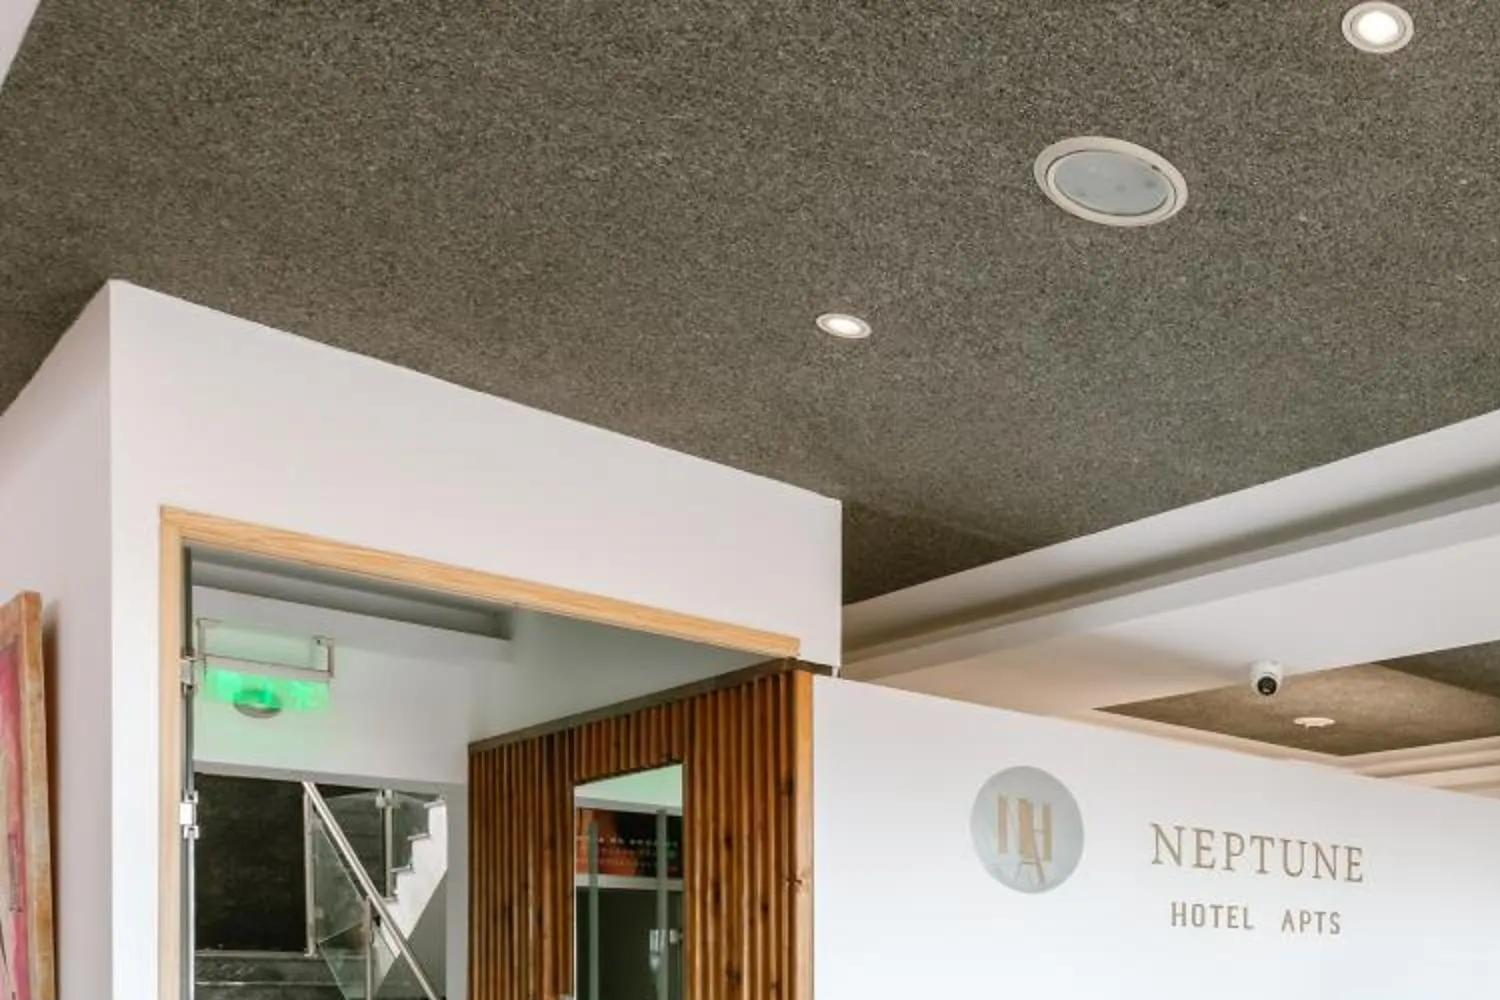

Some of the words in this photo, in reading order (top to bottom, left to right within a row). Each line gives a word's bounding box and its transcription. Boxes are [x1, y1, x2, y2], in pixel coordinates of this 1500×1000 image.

[1150, 823, 1364, 883] NEPTUNE
[1170, 901, 1255, 930] HOTEL
[1280, 909, 1341, 935] APTS
